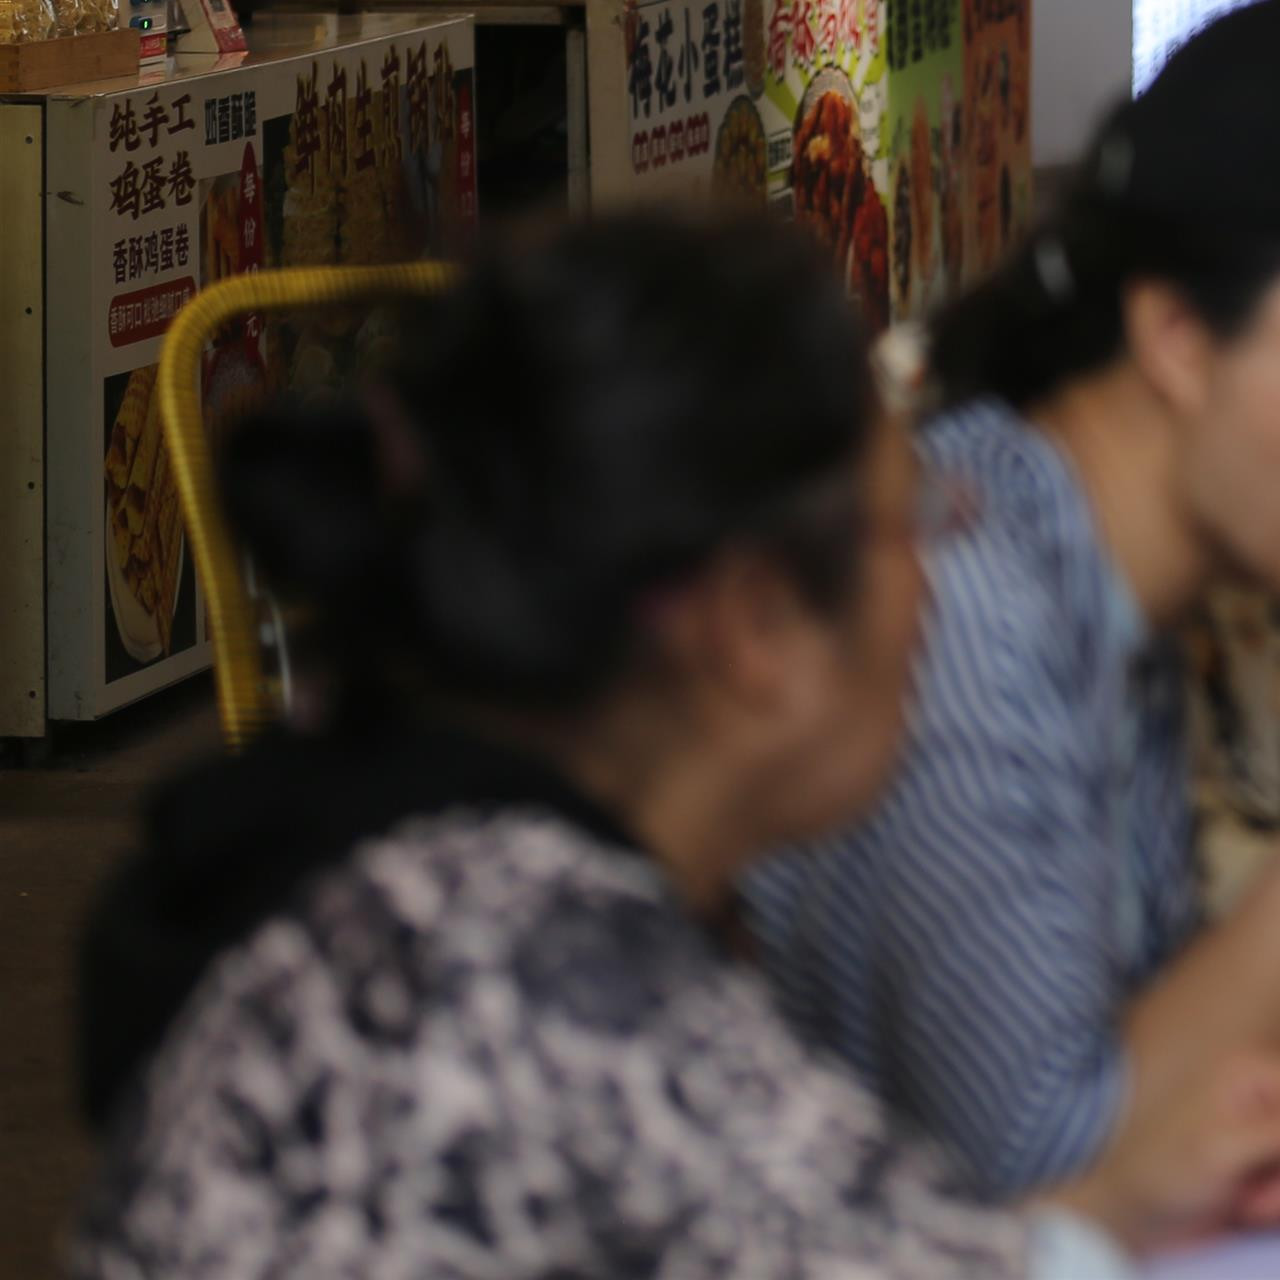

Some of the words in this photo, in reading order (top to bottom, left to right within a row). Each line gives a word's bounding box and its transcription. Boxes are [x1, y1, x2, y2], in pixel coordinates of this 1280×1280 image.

[109, 91, 195, 152] 纯手工
[109, 150, 196, 220] 鸡蛋卷
[113, 223, 190, 284] 香酥鸡蛋卷
